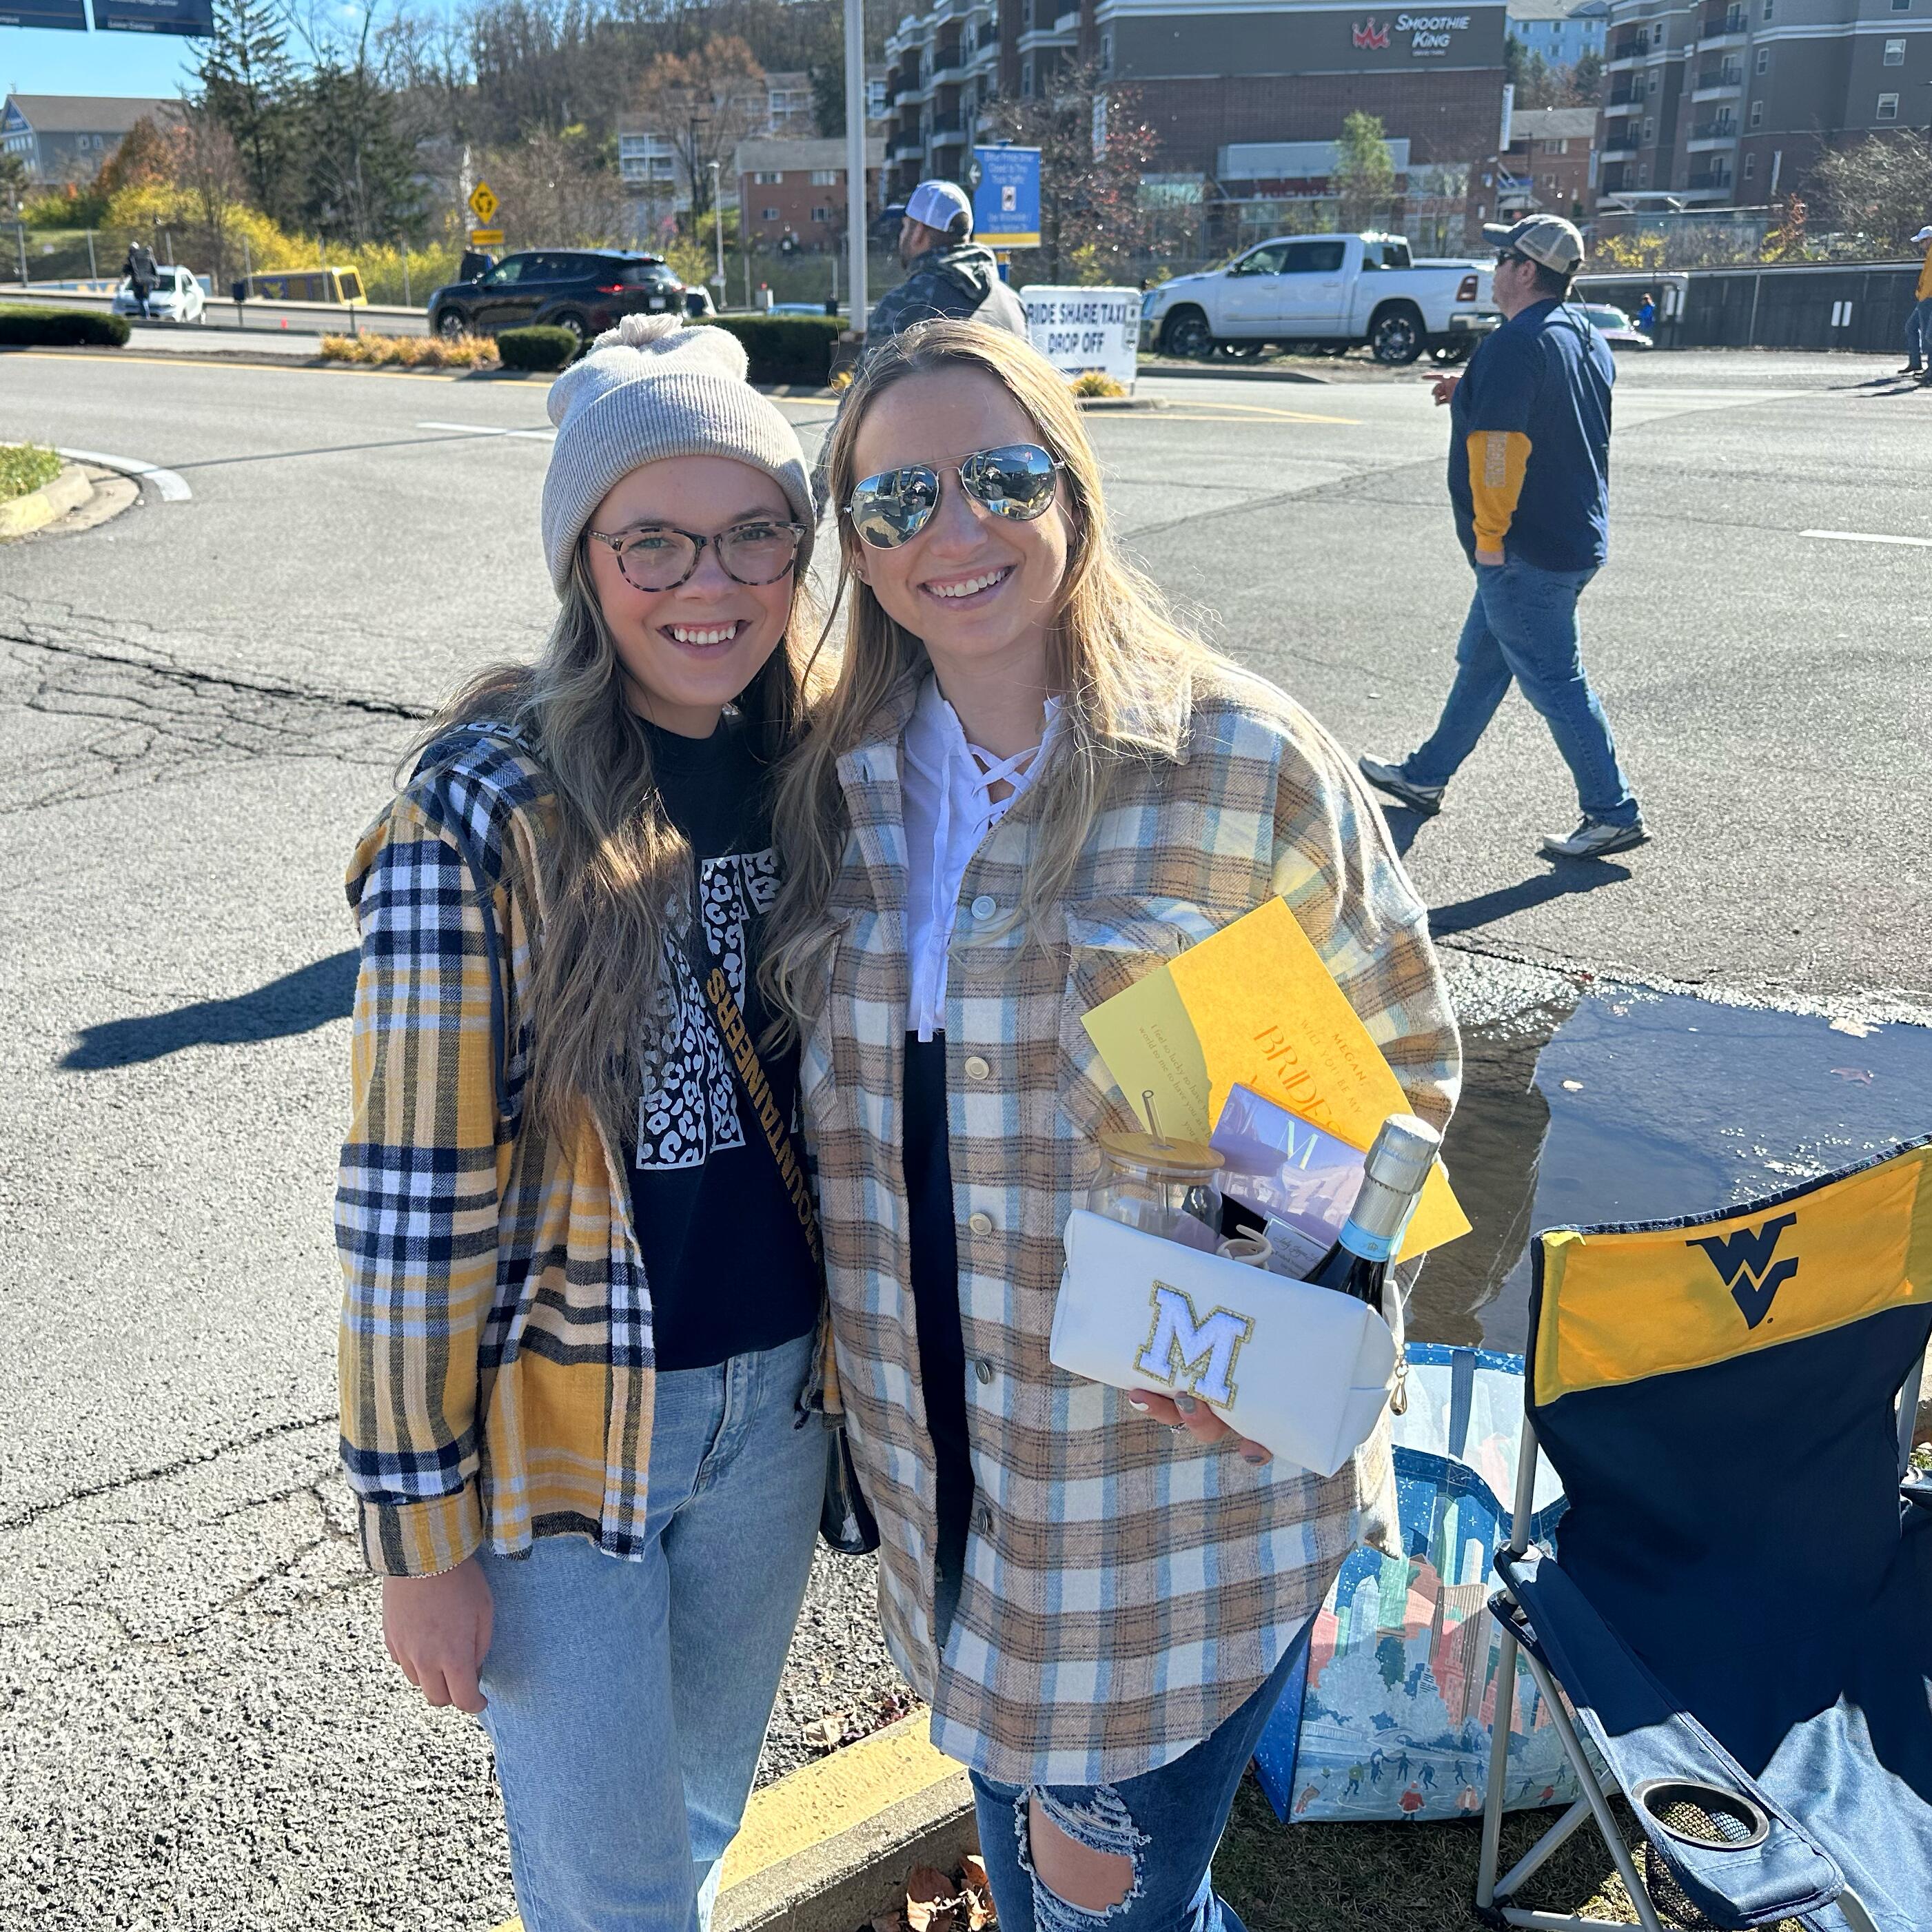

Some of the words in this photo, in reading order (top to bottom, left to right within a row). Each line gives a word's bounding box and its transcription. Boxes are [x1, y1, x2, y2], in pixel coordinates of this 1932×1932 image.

[1395, 14, 1471, 31] SMOOTHIE
[1026, 303, 1056, 325] RIDE
[1048, 333, 1079, 354] DROP
[1081, 332, 1104, 354] OFF
[1139, 1026, 1157, 1049] world
[1152, 1049, 1161, 1060] to
[1158, 1059, 1169, 1072] me
[1167, 1072, 1175, 1082] to
[1173, 1081, 1187, 1101] have
[1183, 1100, 1197, 1117] you
[1153, 1029, 1167, 1044] feel
[1163, 1044, 1170, 1055] so
[1169, 1053, 1185, 1076] lucky
[1183, 1075, 1191, 1086] to
[1189, 1084, 1203, 1106] have
[1301, 1019, 1321, 1046] WILL
[1321, 1049, 1340, 1076] YOU
[1337, 1079, 1351, 1093] BE
[1348, 1097, 1363, 1114] MY
[1332, 1033, 1367, 1087] MEGAN,
[1181, 1119, 1196, 1137] you
[1132, 1279, 1255, 1411] M
